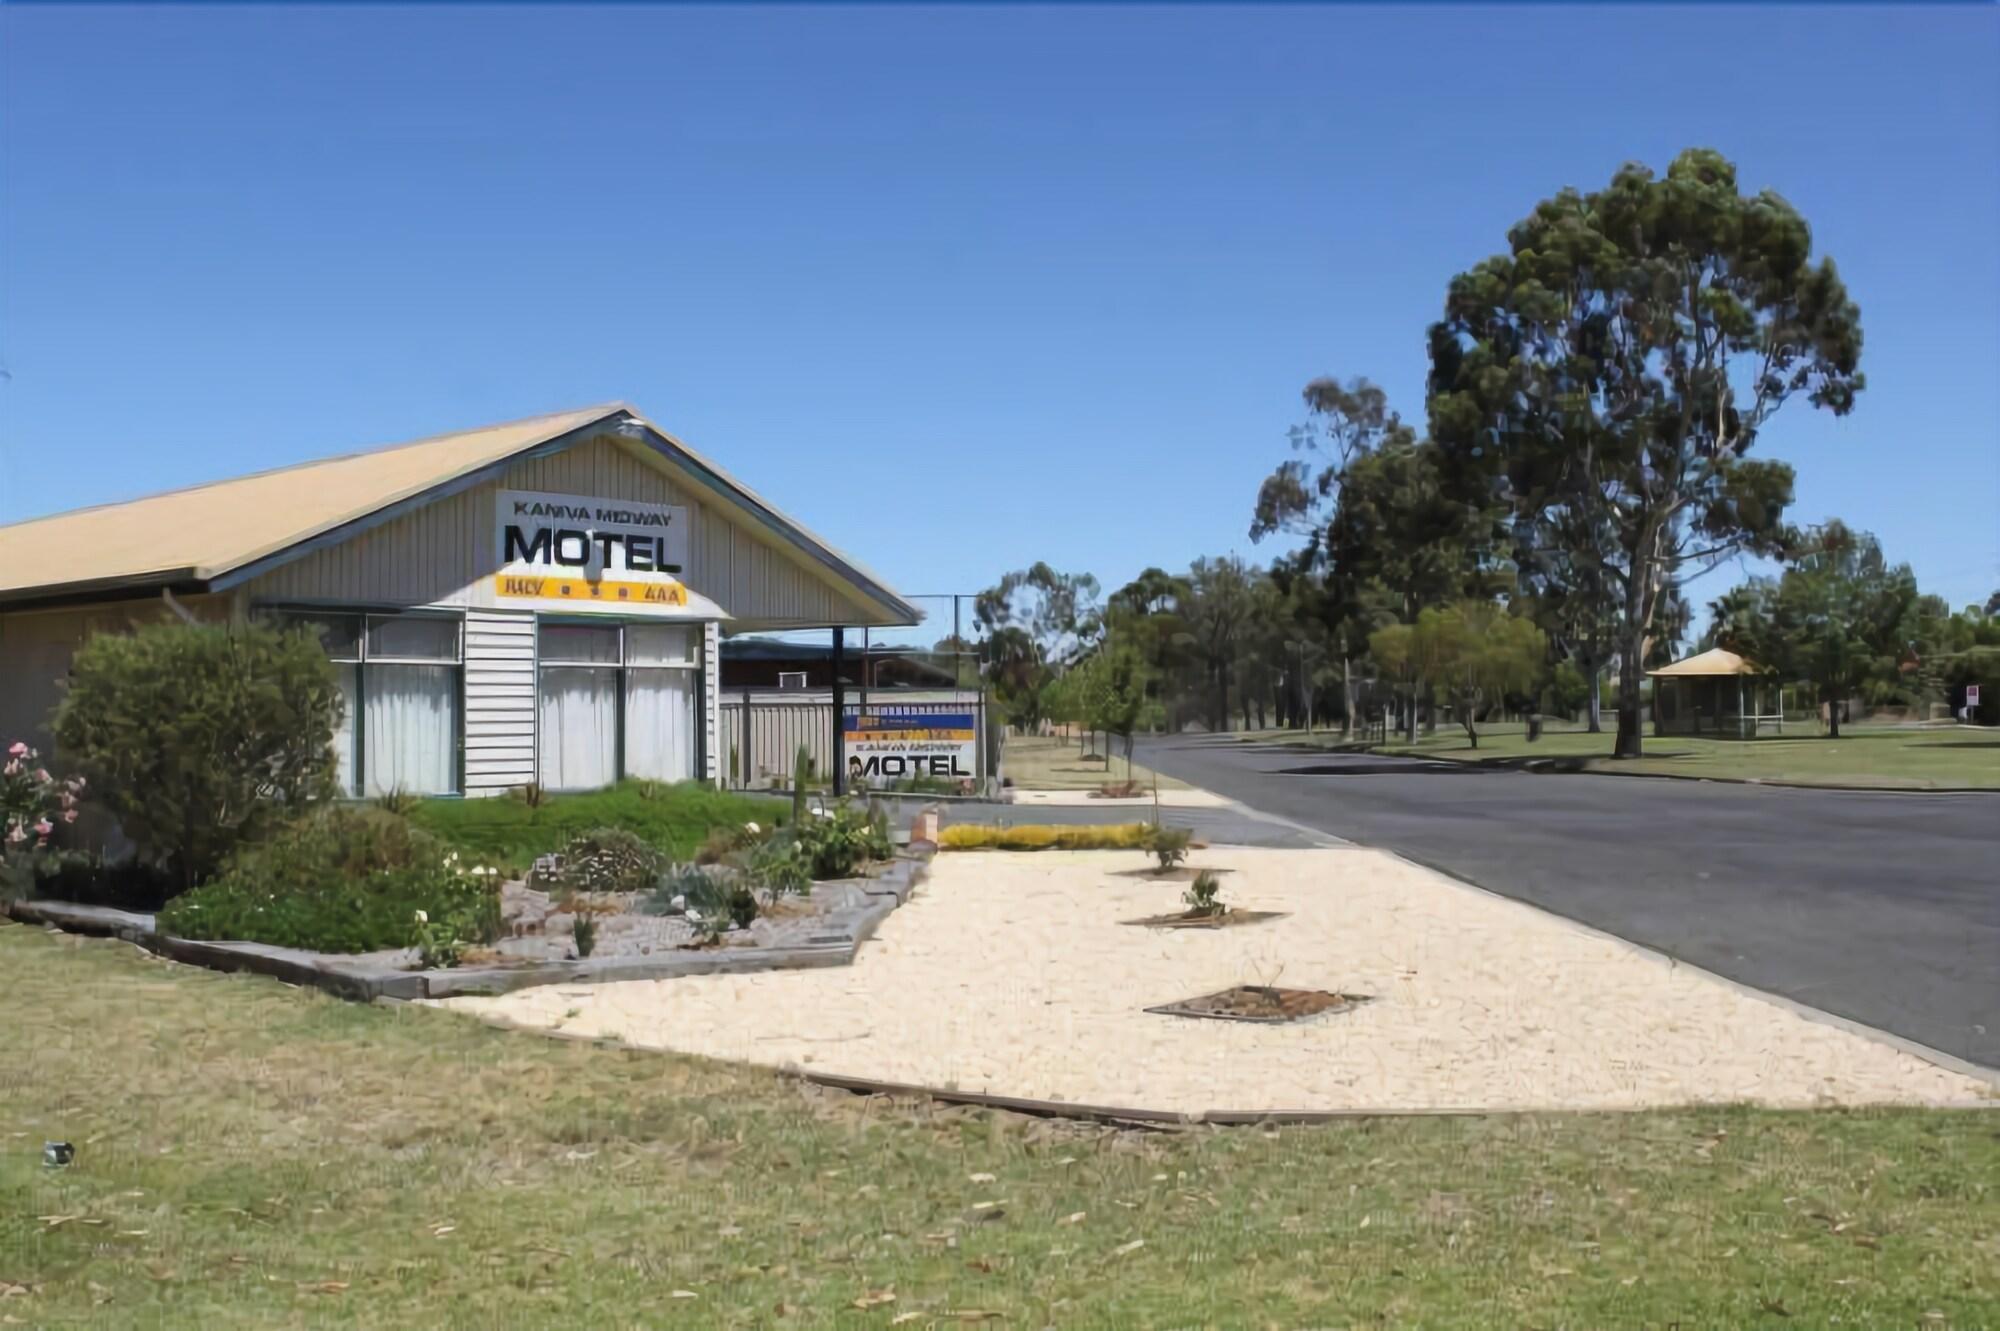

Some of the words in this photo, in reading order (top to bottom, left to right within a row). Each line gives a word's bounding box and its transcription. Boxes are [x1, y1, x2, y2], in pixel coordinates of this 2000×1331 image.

[513, 501, 591, 521] KANIVA
[596, 508, 672, 527] MIDWAY
[504, 525, 682, 573] MOTEL
[849, 755, 970, 777] MOTEL
